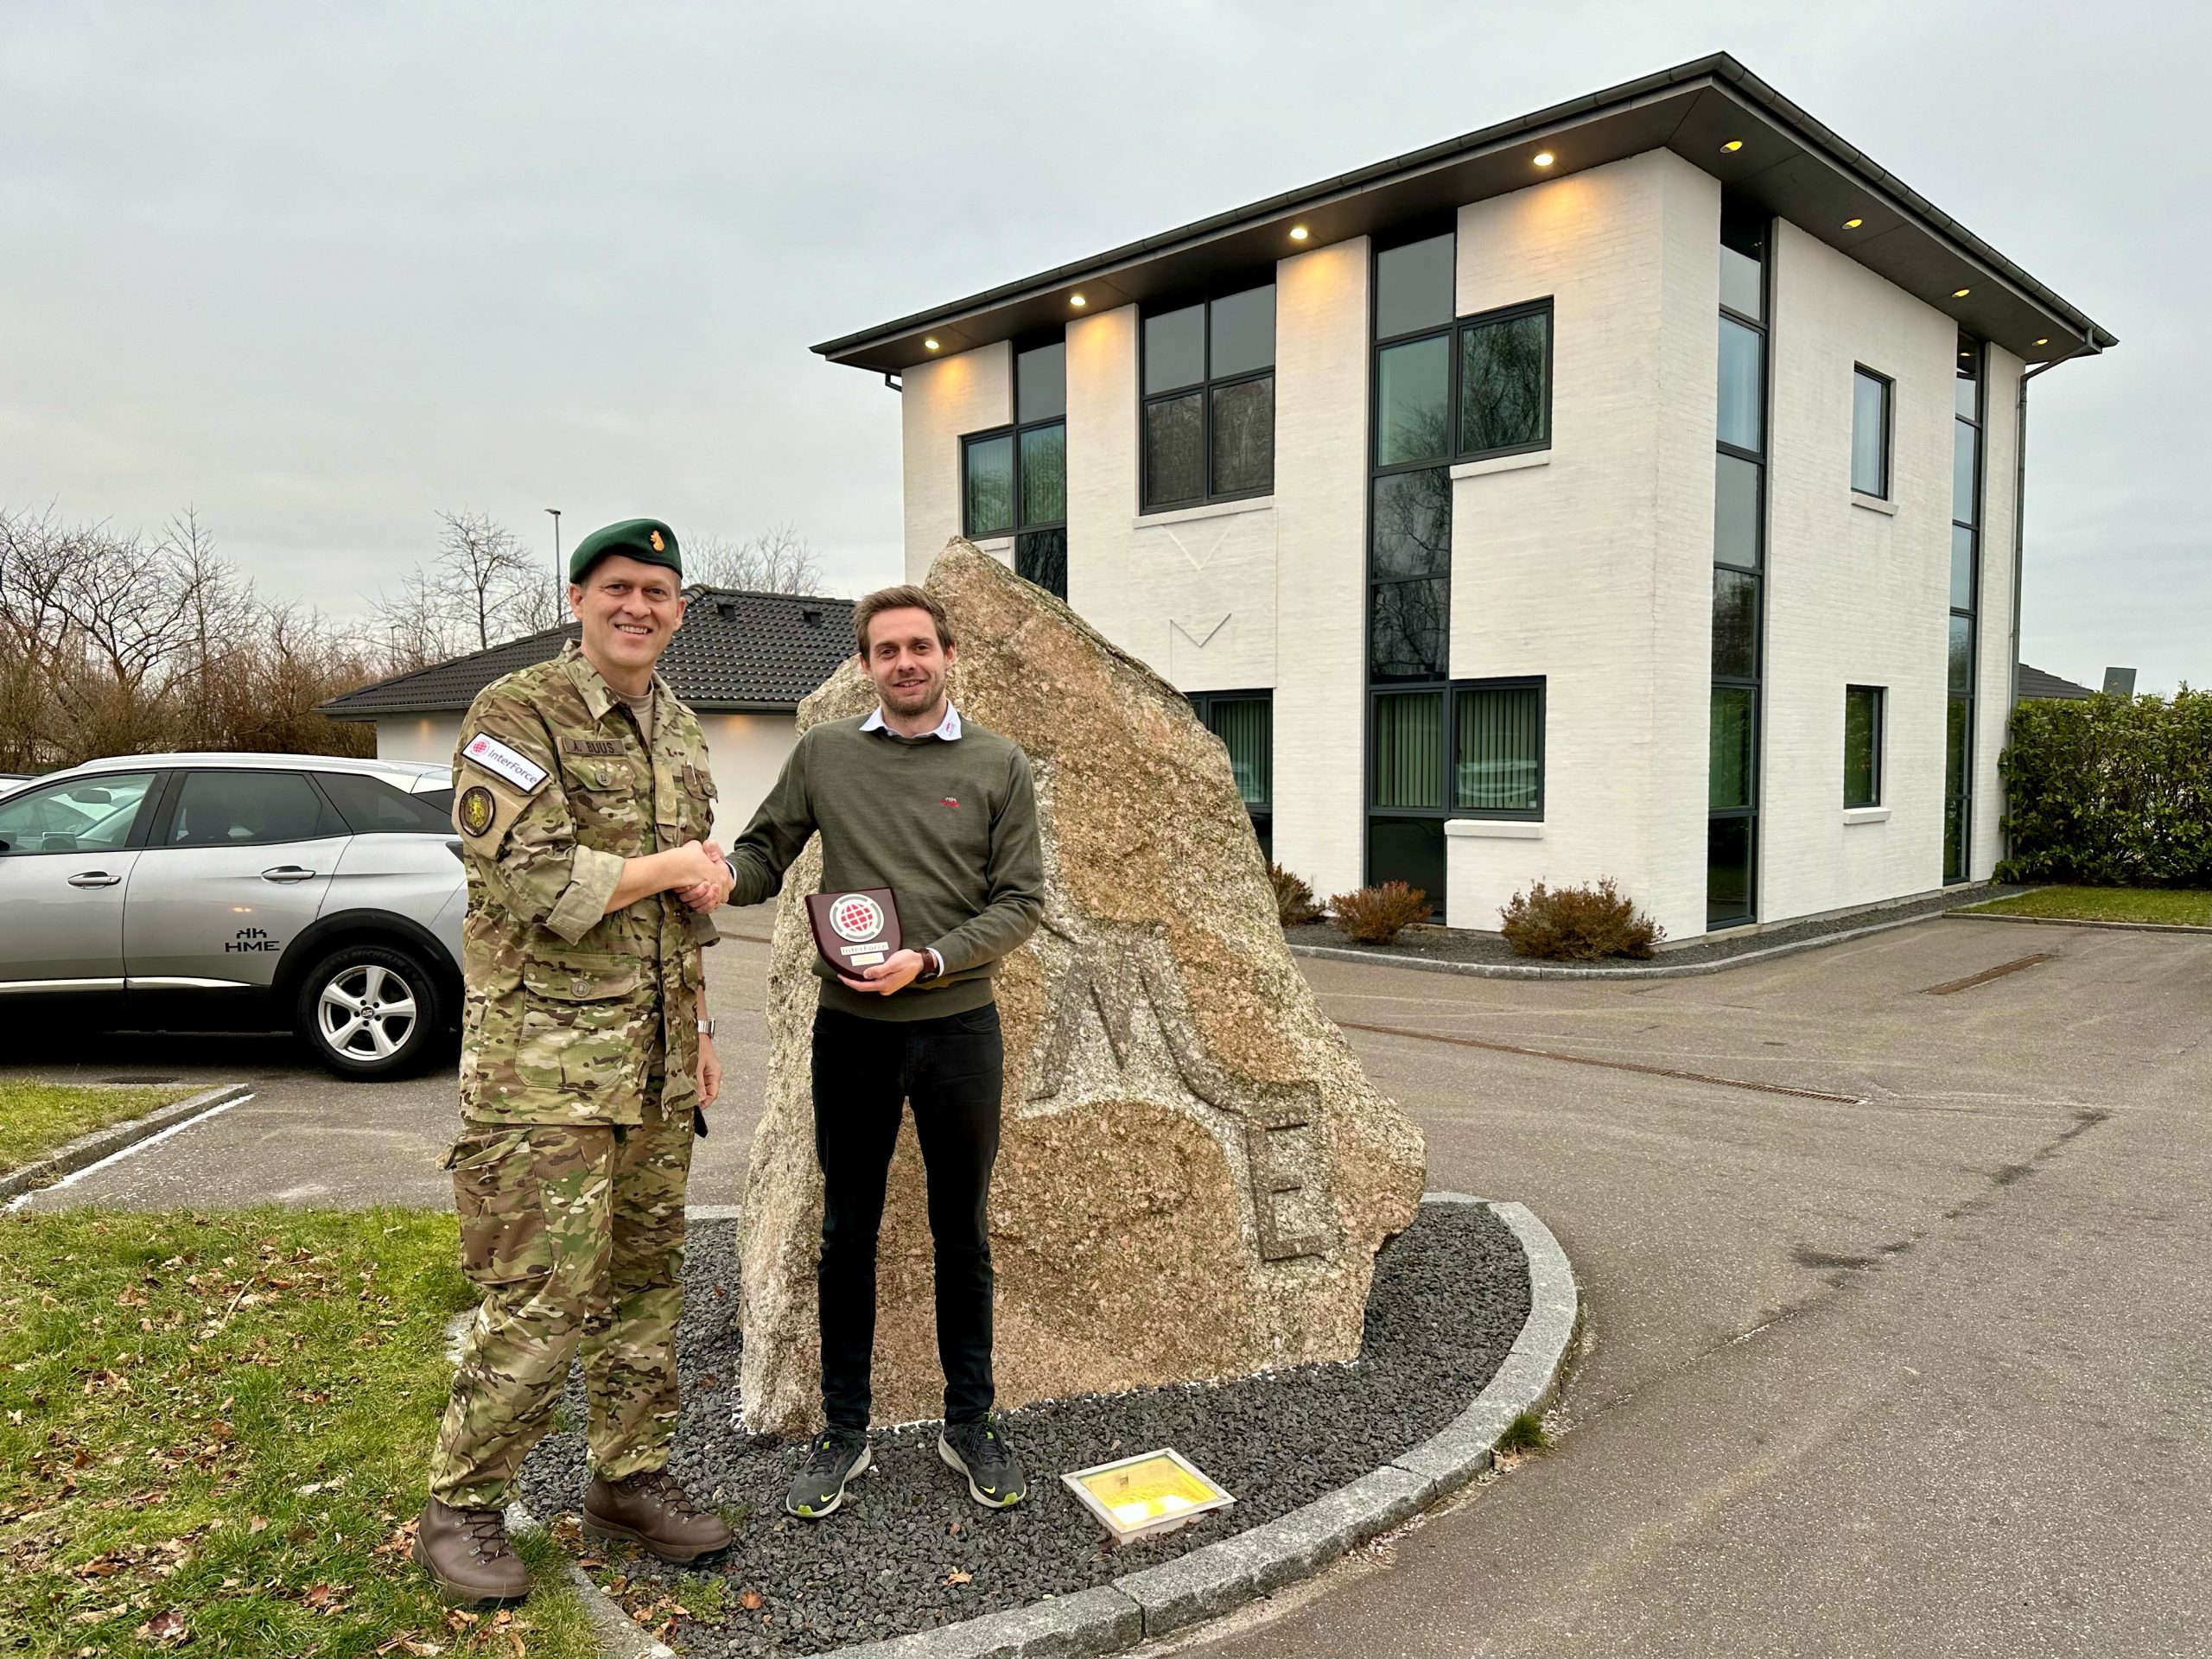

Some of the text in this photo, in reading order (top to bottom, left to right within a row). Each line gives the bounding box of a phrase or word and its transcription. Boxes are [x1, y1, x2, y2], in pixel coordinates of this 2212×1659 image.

[586, 741, 614, 753] BUUS
[488, 749, 537, 784] InterForce
[225, 940, 280, 953] HME
[1025, 918, 1331, 1264] ME
